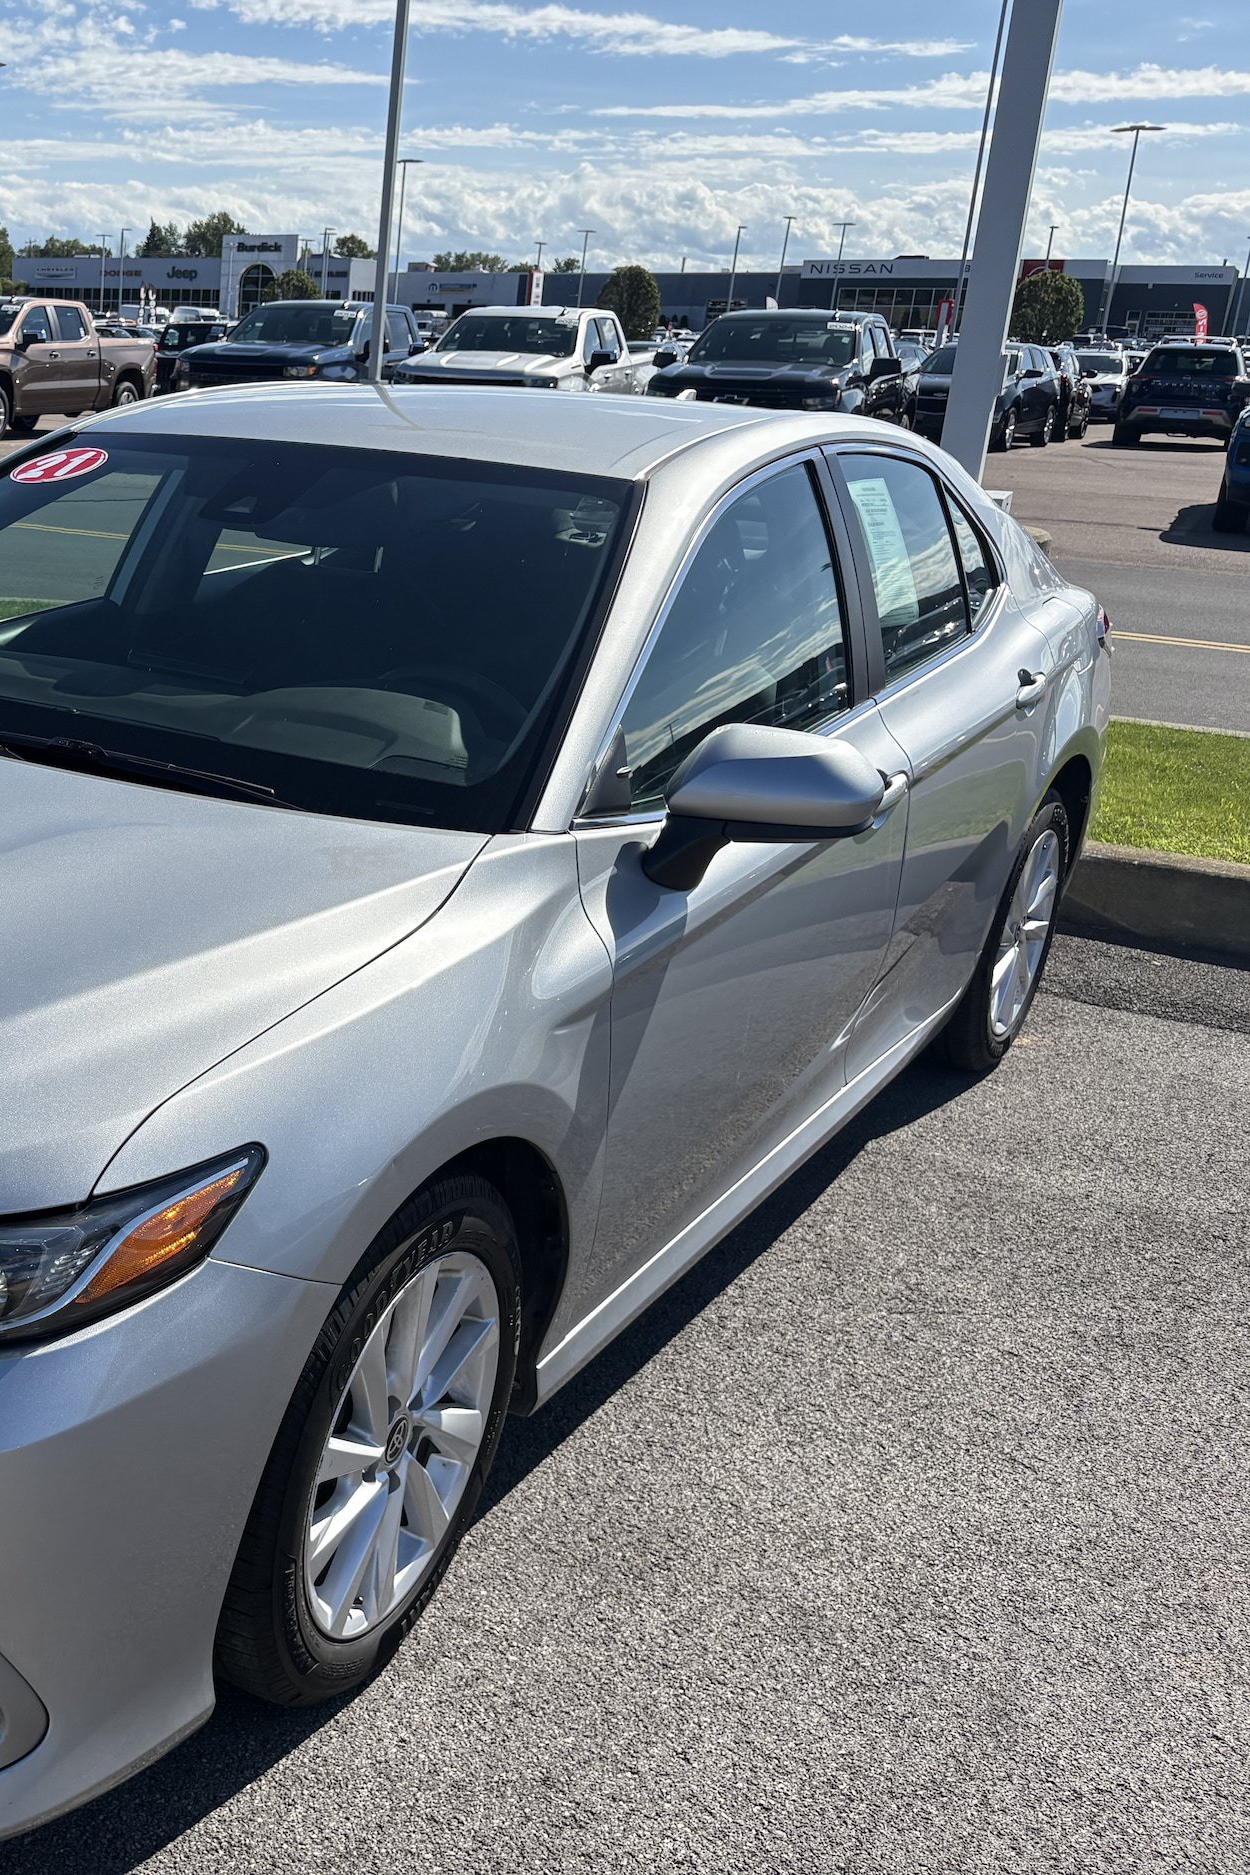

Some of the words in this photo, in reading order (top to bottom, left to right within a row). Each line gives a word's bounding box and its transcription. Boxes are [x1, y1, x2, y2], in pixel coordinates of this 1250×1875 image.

[237, 241, 282, 252] Burdick
[166, 265, 198, 281] Jeep
[810, 263, 894, 274] NISSAN
[16, 451, 97, 480] 21
